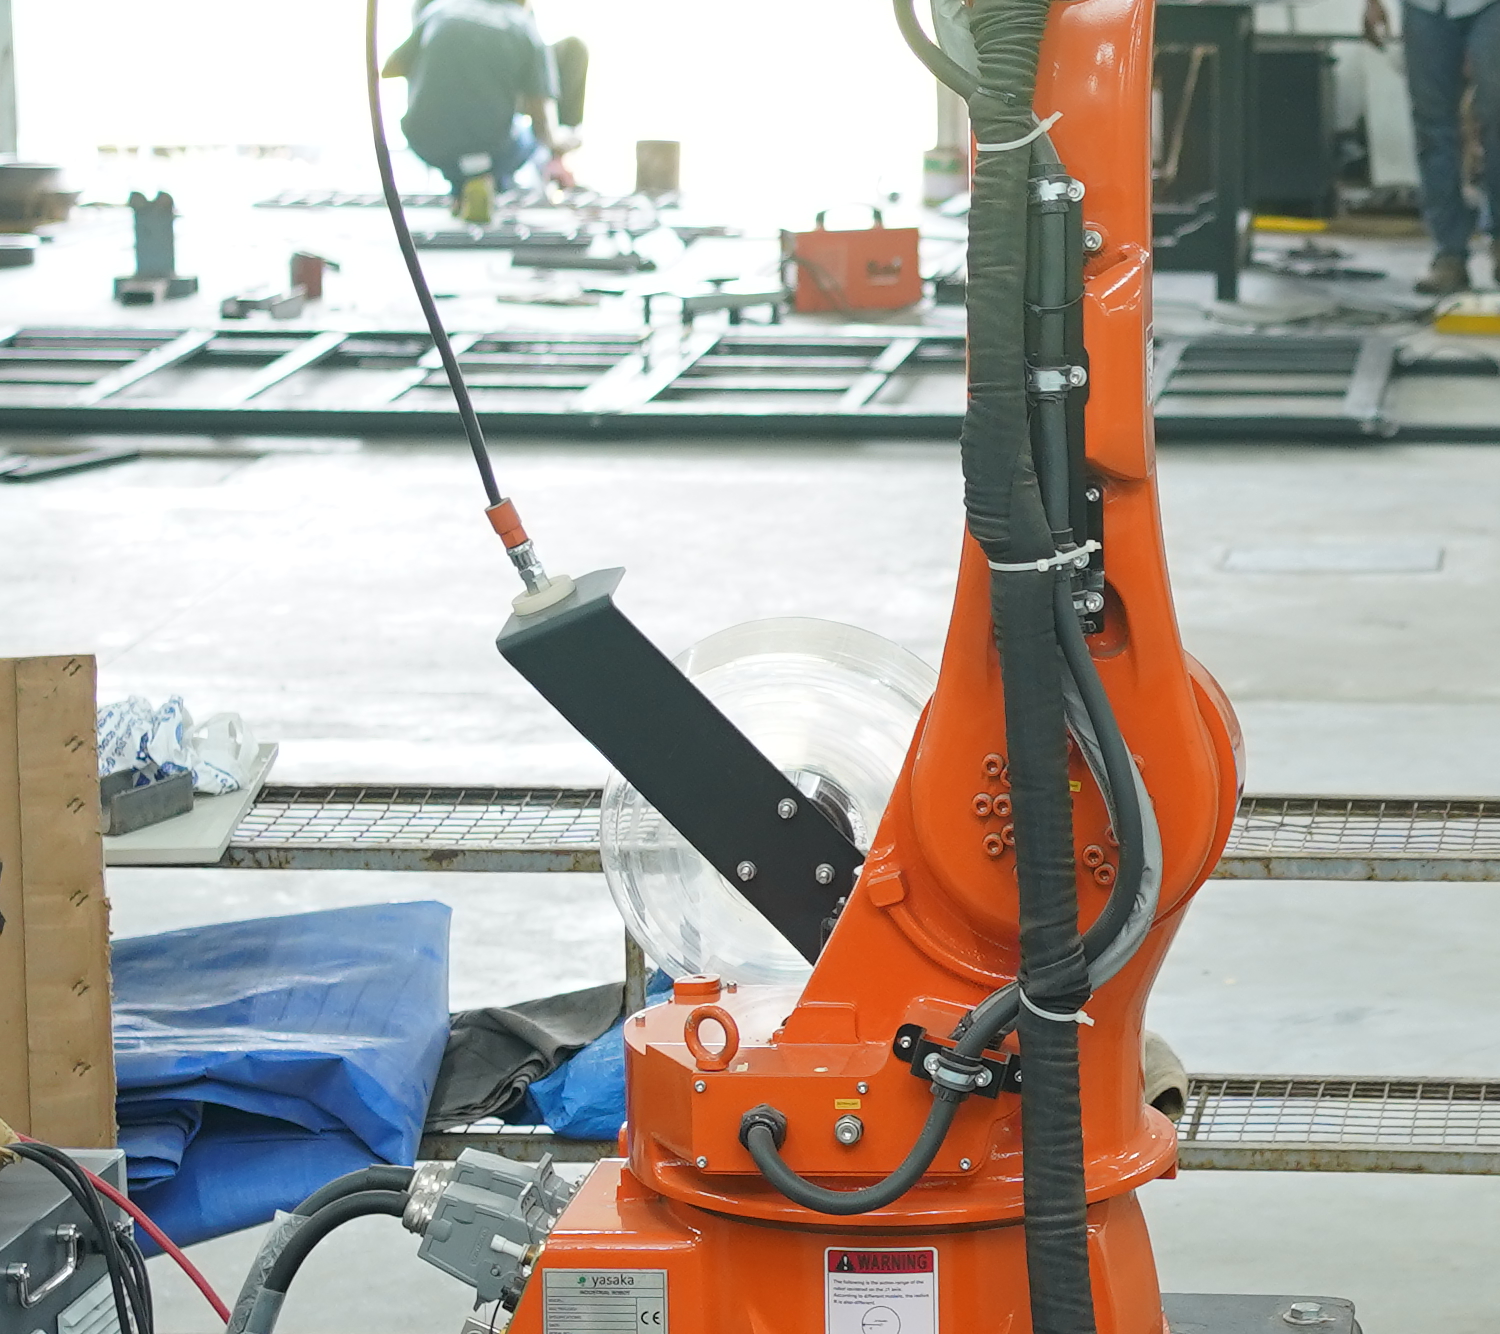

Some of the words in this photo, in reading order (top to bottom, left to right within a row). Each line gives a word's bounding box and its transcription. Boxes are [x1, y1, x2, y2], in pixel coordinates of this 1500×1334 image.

[857, 1254, 928, 1270] WARNING
[592, 1274, 634, 1287] yasaka
[641, 1311, 661, 1325] CE
